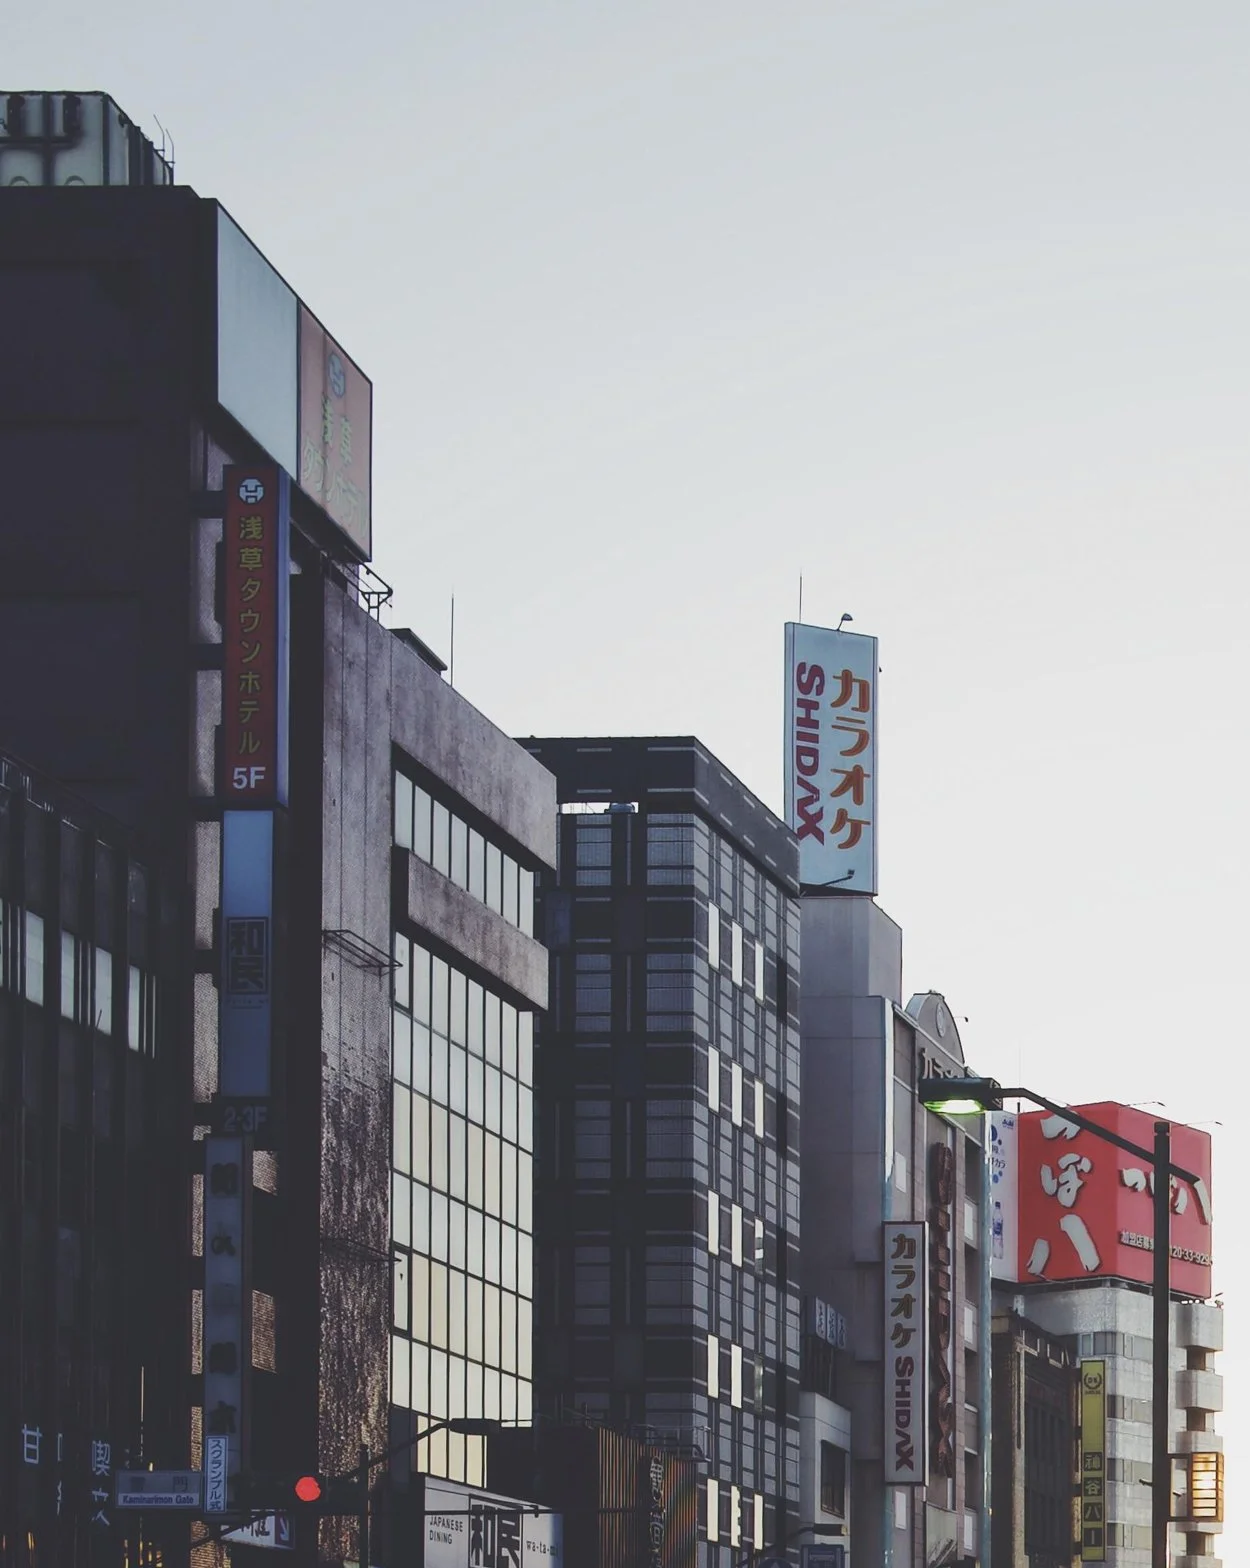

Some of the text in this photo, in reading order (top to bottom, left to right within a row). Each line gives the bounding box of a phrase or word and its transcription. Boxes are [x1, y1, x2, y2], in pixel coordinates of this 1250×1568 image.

[239, 516, 264, 755] 浅草タウンホテル
[233, 766, 267, 790] 5F
[795, 661, 826, 846] SHIDAX
[829, 668, 871, 849] カラオケ
[1026, 1112, 1101, 1274] つぼ八
[890, 1233, 917, 1472] カラオケ SHIDAX
[123, 1495, 195, 1504] Kaminarimon Gate
[209, 1439, 222, 1511] スクランブル式
[1083, 1453, 1103, 1546] 神谷バー
[429, 1515, 464, 1533] JAPANESE
[429, 1530, 453, 1544] DINING
